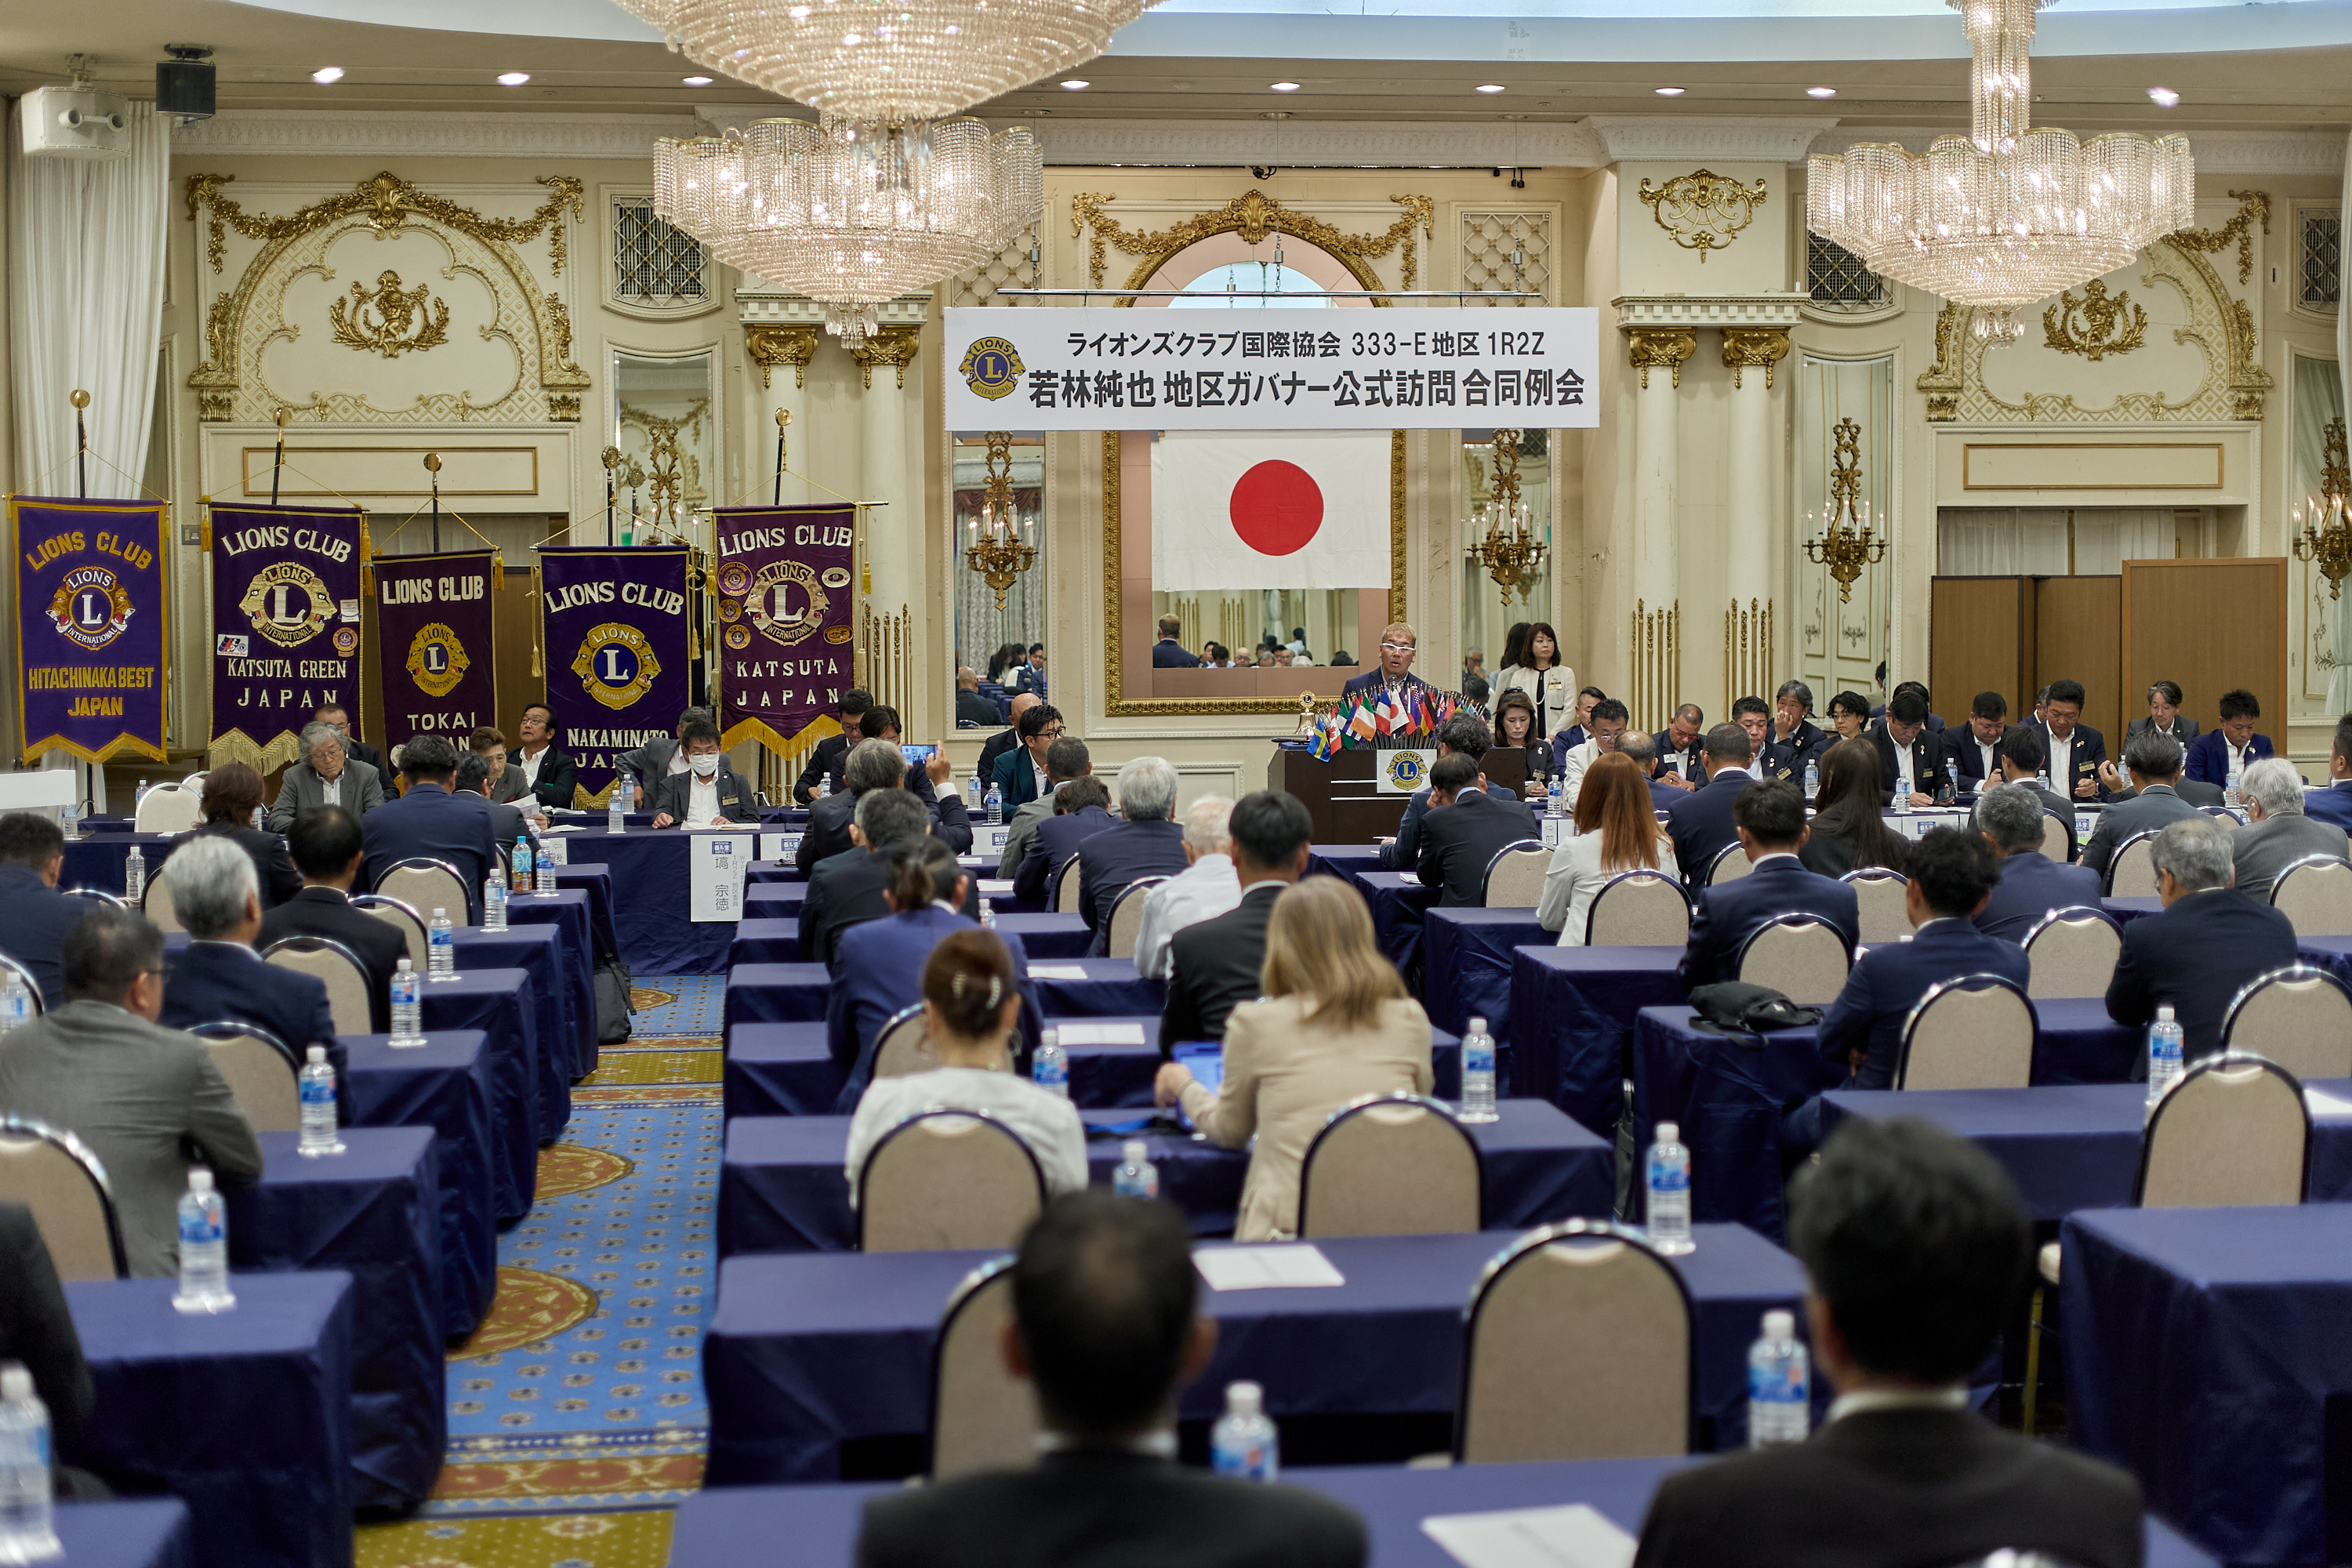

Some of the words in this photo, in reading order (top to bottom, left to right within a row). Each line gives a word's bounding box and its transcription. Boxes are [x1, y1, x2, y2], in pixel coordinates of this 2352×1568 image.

[973, 339, 1011, 353] LIONS
[1067, 331, 1341, 358] ライオンズクラブ国際協会
[1488, 332, 1545, 356] 1R2Z
[985, 357, 1003, 378] L
[974, 384, 1012, 396] INTERNATIONAL
[220, 526, 289, 557] LIONS
[294, 528, 351, 563] CLUB
[718, 527, 786, 557] LIONS
[794, 524, 853, 547] CLUB
[25, 532, 85, 570] LIONS
[96, 532, 152, 569] CLUB
[67, 571, 112, 588] LIONS
[267, 567, 310, 583] LIONS
[763, 564, 809, 582] LIONS
[383, 578, 433, 604] LIONS
[438, 575, 484, 601] CLUB
[544, 581, 615, 614] LIONS
[621, 582, 684, 615] CLUB
[82, 594, 102, 624] L
[272, 586, 306, 623] L
[772, 584, 804, 621] L
[67, 627, 118, 644] INTERNATIONAL
[263, 622, 313, 640] INTERNATIONAL
[421, 628, 451, 643] LIONS
[592, 628, 639, 645] LIONS
[766, 625, 812, 640] INTERNATIONAL
[427, 646, 445, 670] L
[603, 649, 629, 680] L
[736, 658, 838, 677] KATSUTA
[227, 658, 293, 678] KATSUTA
[299, 660, 347, 678] GREEN
[28, 667, 117, 689] HITACHINAKA
[118, 667, 154, 688] BEST
[419, 676, 455, 689] INTERNATIONAL
[237, 688, 338, 708] JAPAN
[591, 685, 641, 700] INTERNATIONAL
[736, 688, 839, 707] JAPAN
[67, 697, 123, 716] JAPAN
[407, 711, 476, 731] TOKAI
[1403, 763, 1414, 777] L
